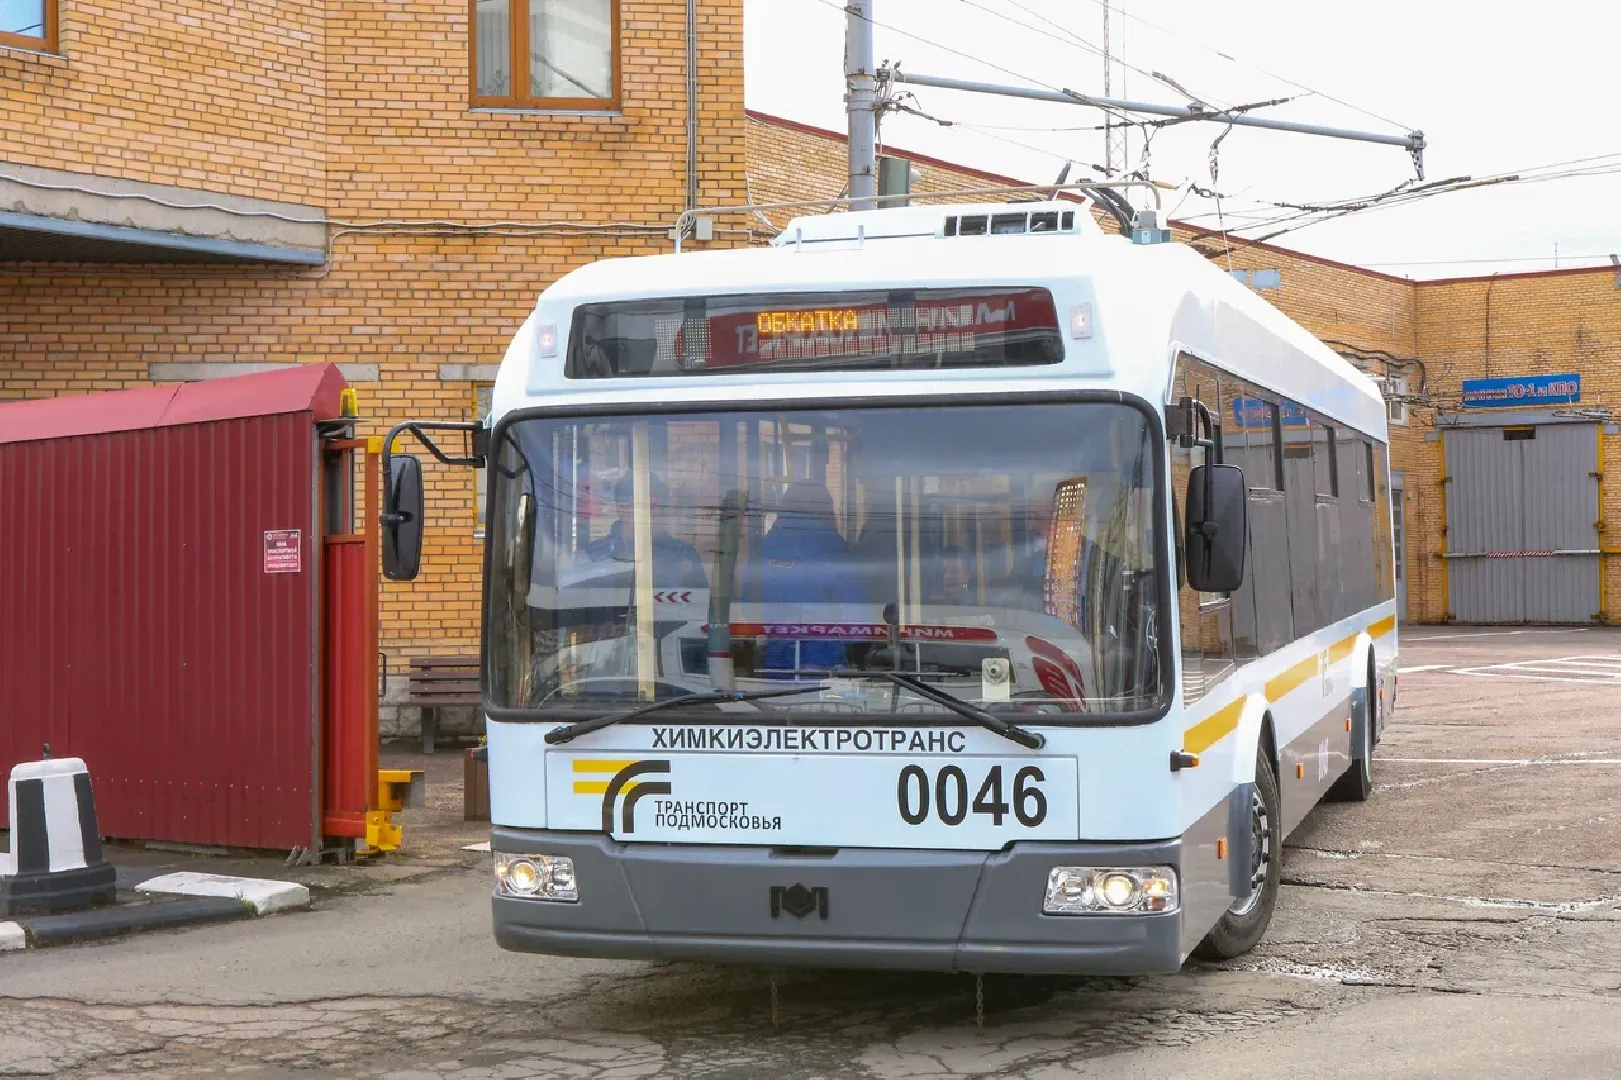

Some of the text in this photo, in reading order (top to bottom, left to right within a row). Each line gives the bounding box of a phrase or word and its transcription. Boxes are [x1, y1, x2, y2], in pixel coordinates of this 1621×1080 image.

[758, 310, 858, 332] ОБКАТКА
[652, 728, 966, 752] ХИМКИЭЛЕКТРОТРАНС
[897, 764, 1048, 828] 0046
[655, 801, 749, 816] ТРАНСПОРТ
[655, 814, 782, 831] ПОДМОСКОВЬЯ
